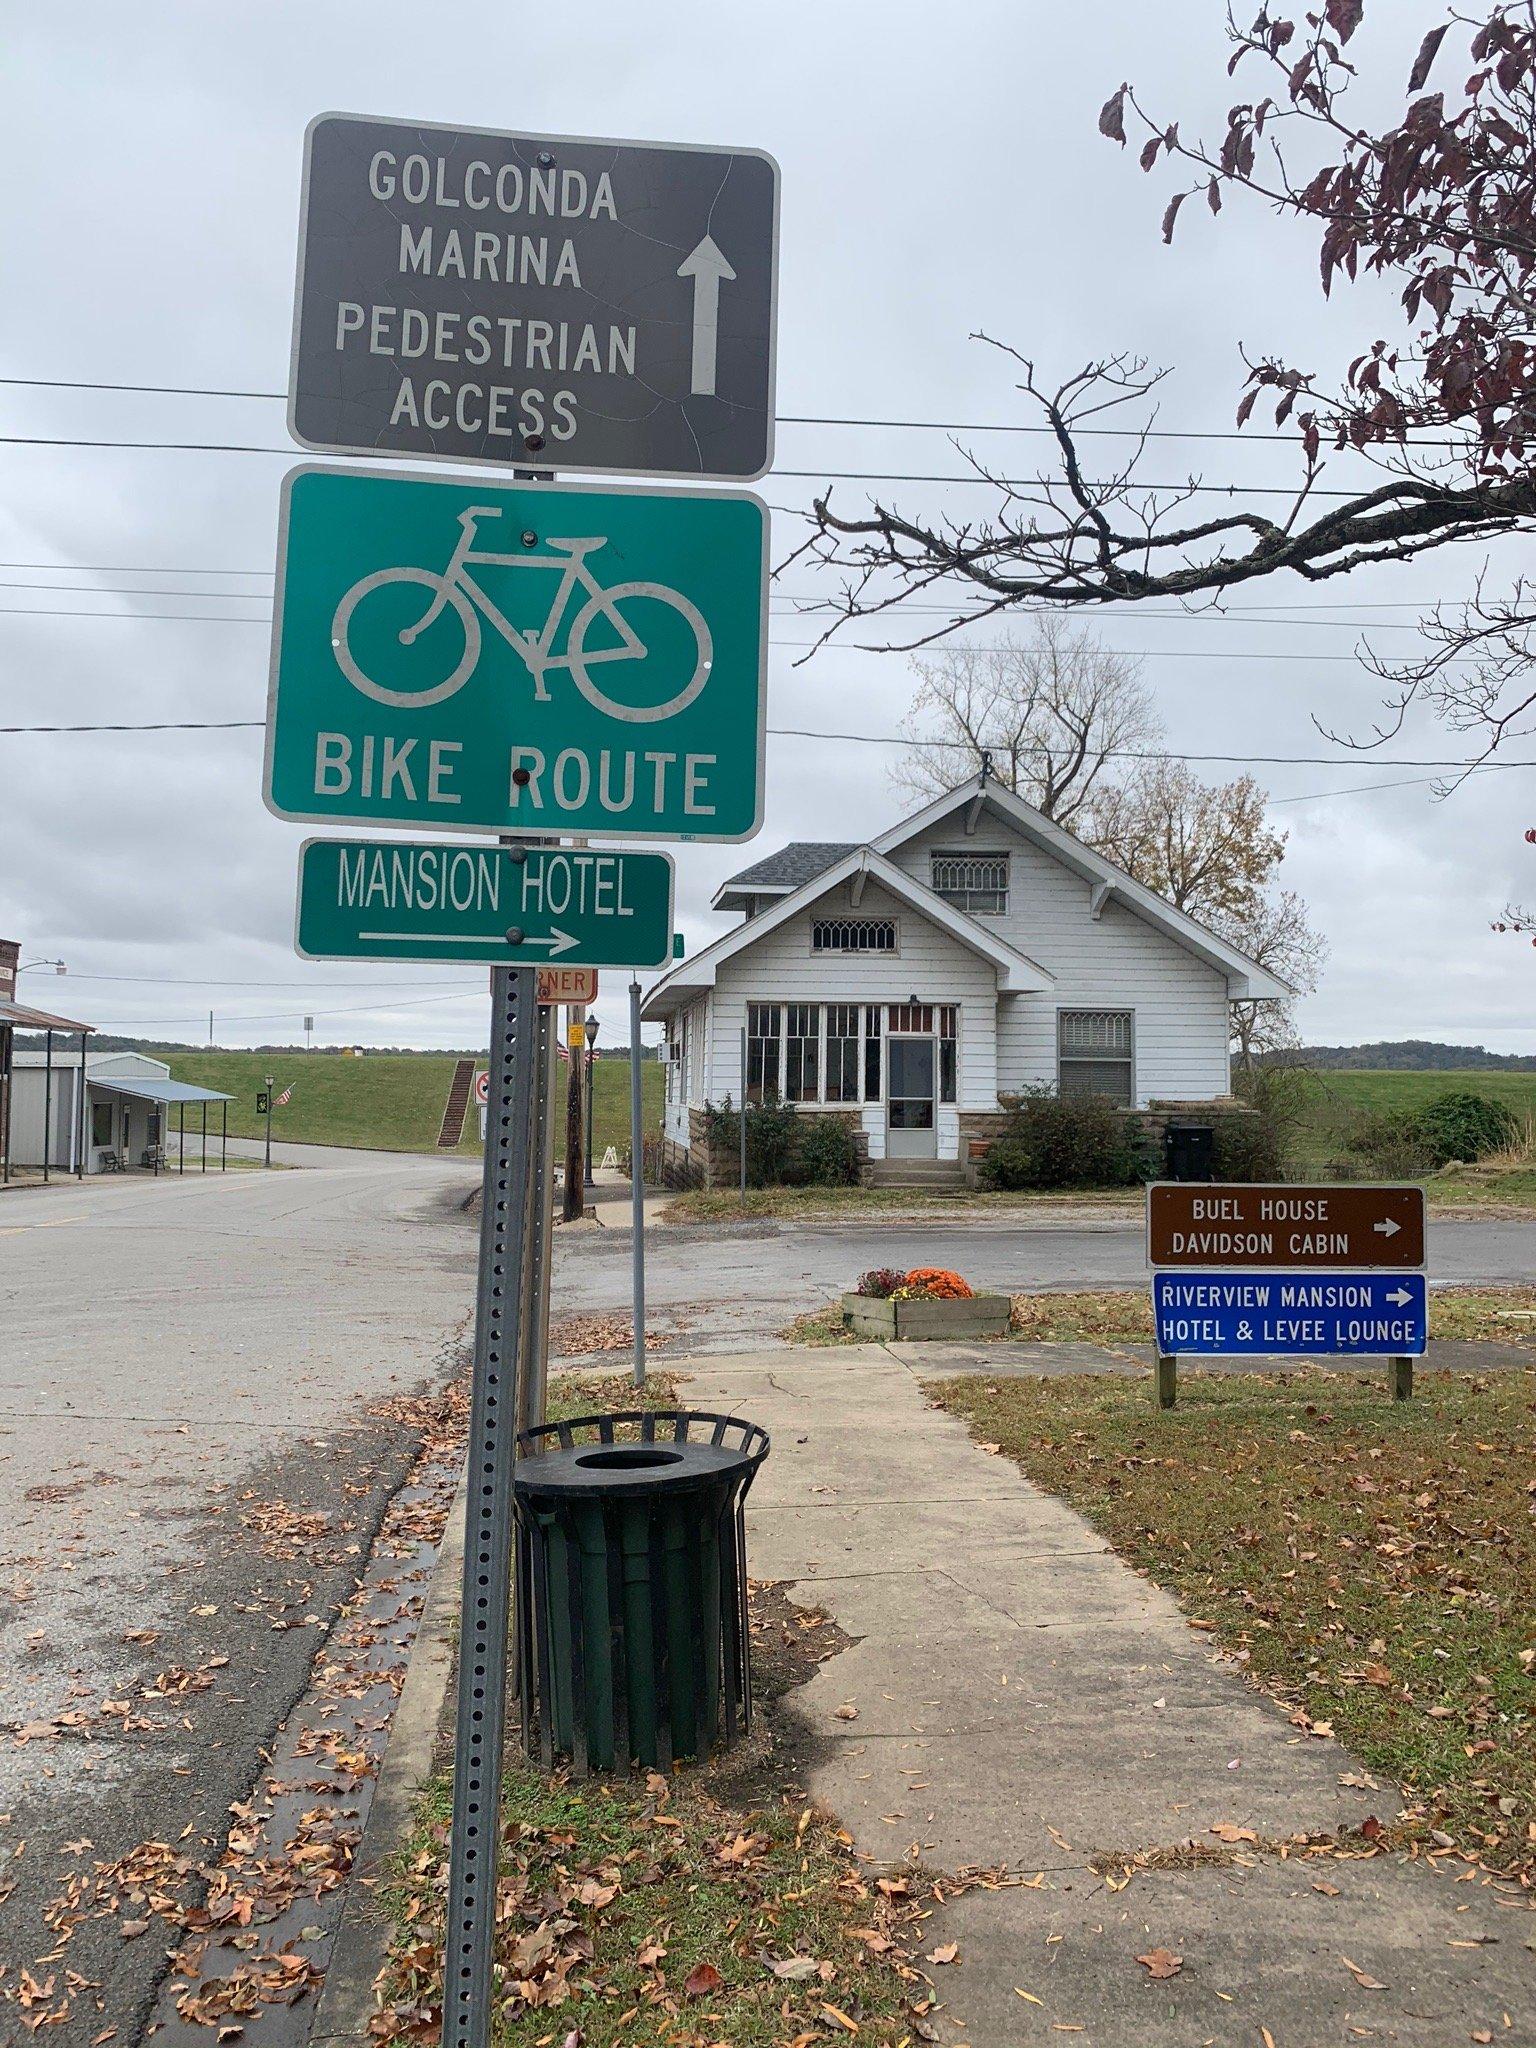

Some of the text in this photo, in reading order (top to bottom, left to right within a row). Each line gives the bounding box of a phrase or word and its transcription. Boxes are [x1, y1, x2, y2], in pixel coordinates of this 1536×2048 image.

[369, 150, 618, 221] GOLCONDA
[399, 223, 582, 288] MARINA
[336, 301, 636, 376] PEDESTRIAN
[389, 377, 578, 441] ACCESS
[314, 732, 717, 815] BIKE ROUTE
[337, 848, 634, 917] MANSION HOTEL
[1192, 1199, 1329, 1221] BUEL HOUSE
[1173, 1233, 1349, 1255] DAVIDSON CABIN
[1162, 1285, 1372, 1307] RIVERVIEW MANSION
[1163, 1320, 1415, 1341] HOTEL & LEVEE LOUNGE
